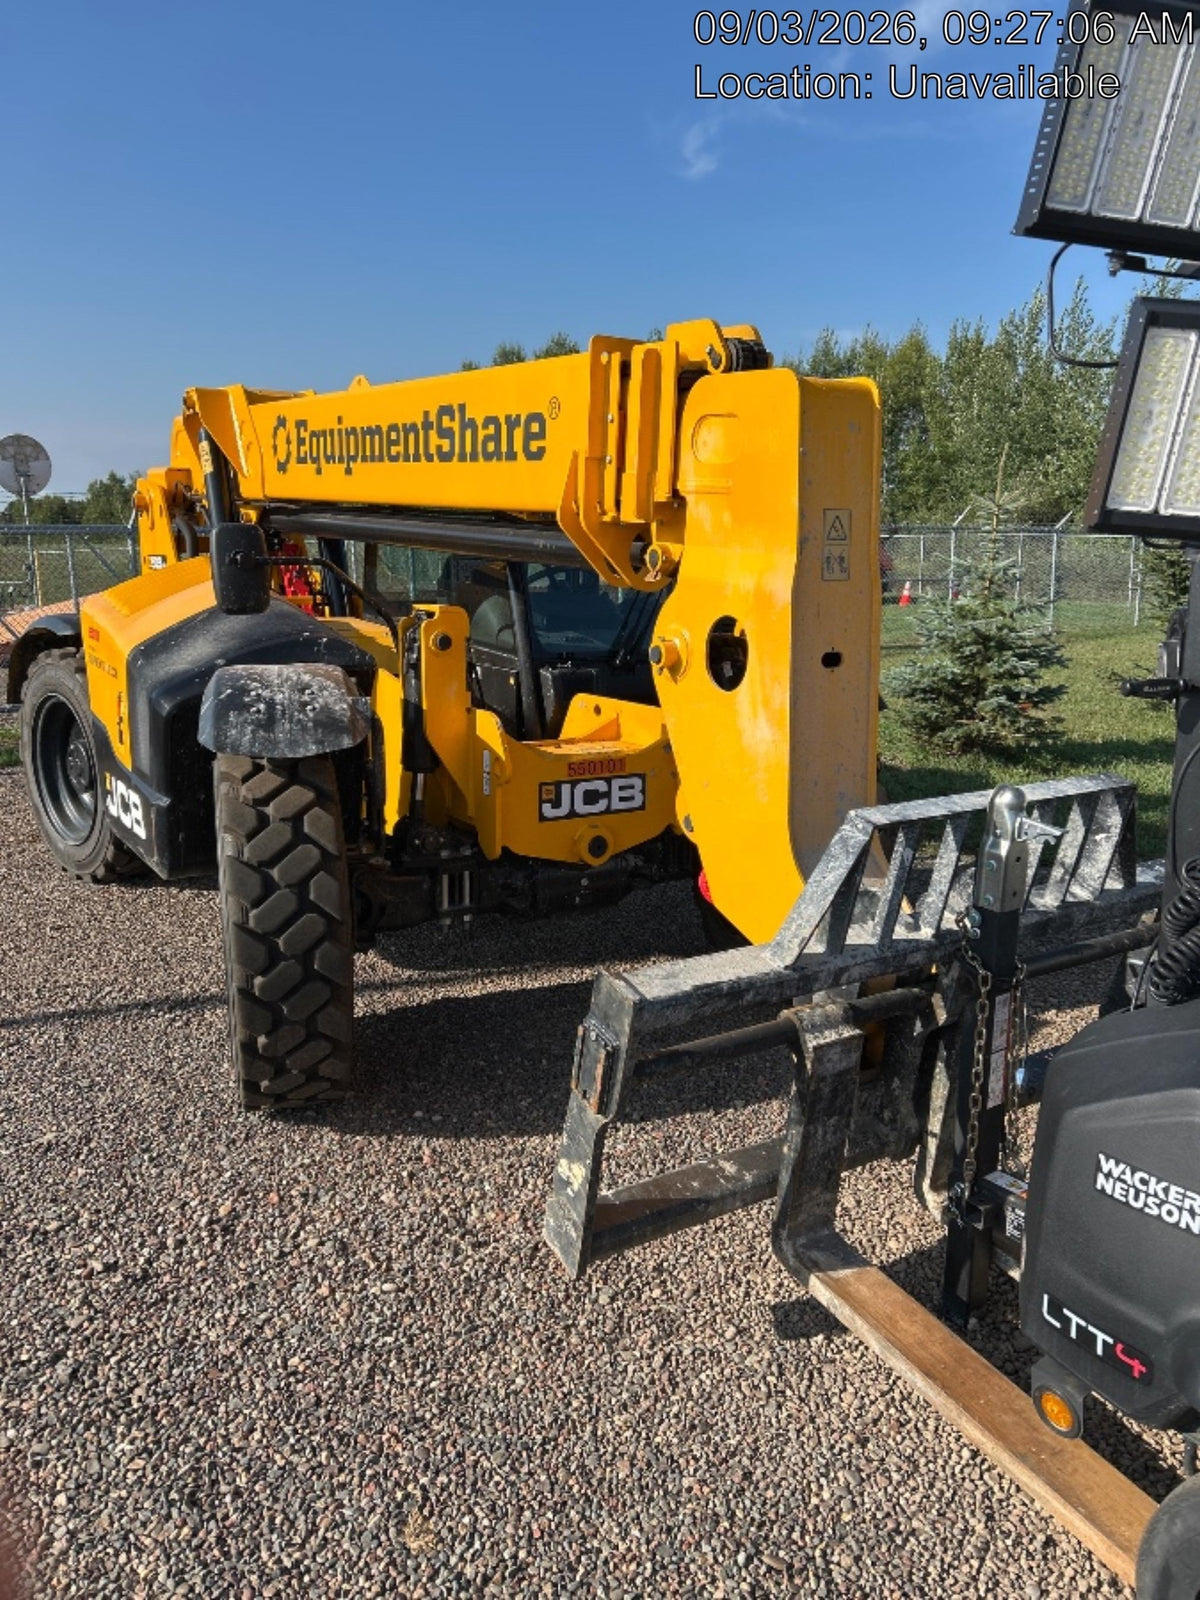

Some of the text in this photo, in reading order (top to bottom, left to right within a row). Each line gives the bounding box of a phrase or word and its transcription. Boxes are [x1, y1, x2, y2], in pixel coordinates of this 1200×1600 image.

[294, 402, 547, 476] EquipmentShare
[106, 776, 146, 839] JCB
[541, 777, 644, 819] JCB
[1095, 1172, 1200, 1235] NEUSON
[1098, 1153, 1200, 1215] WACKER
[1042, 1293, 1147, 1379] LTT4
